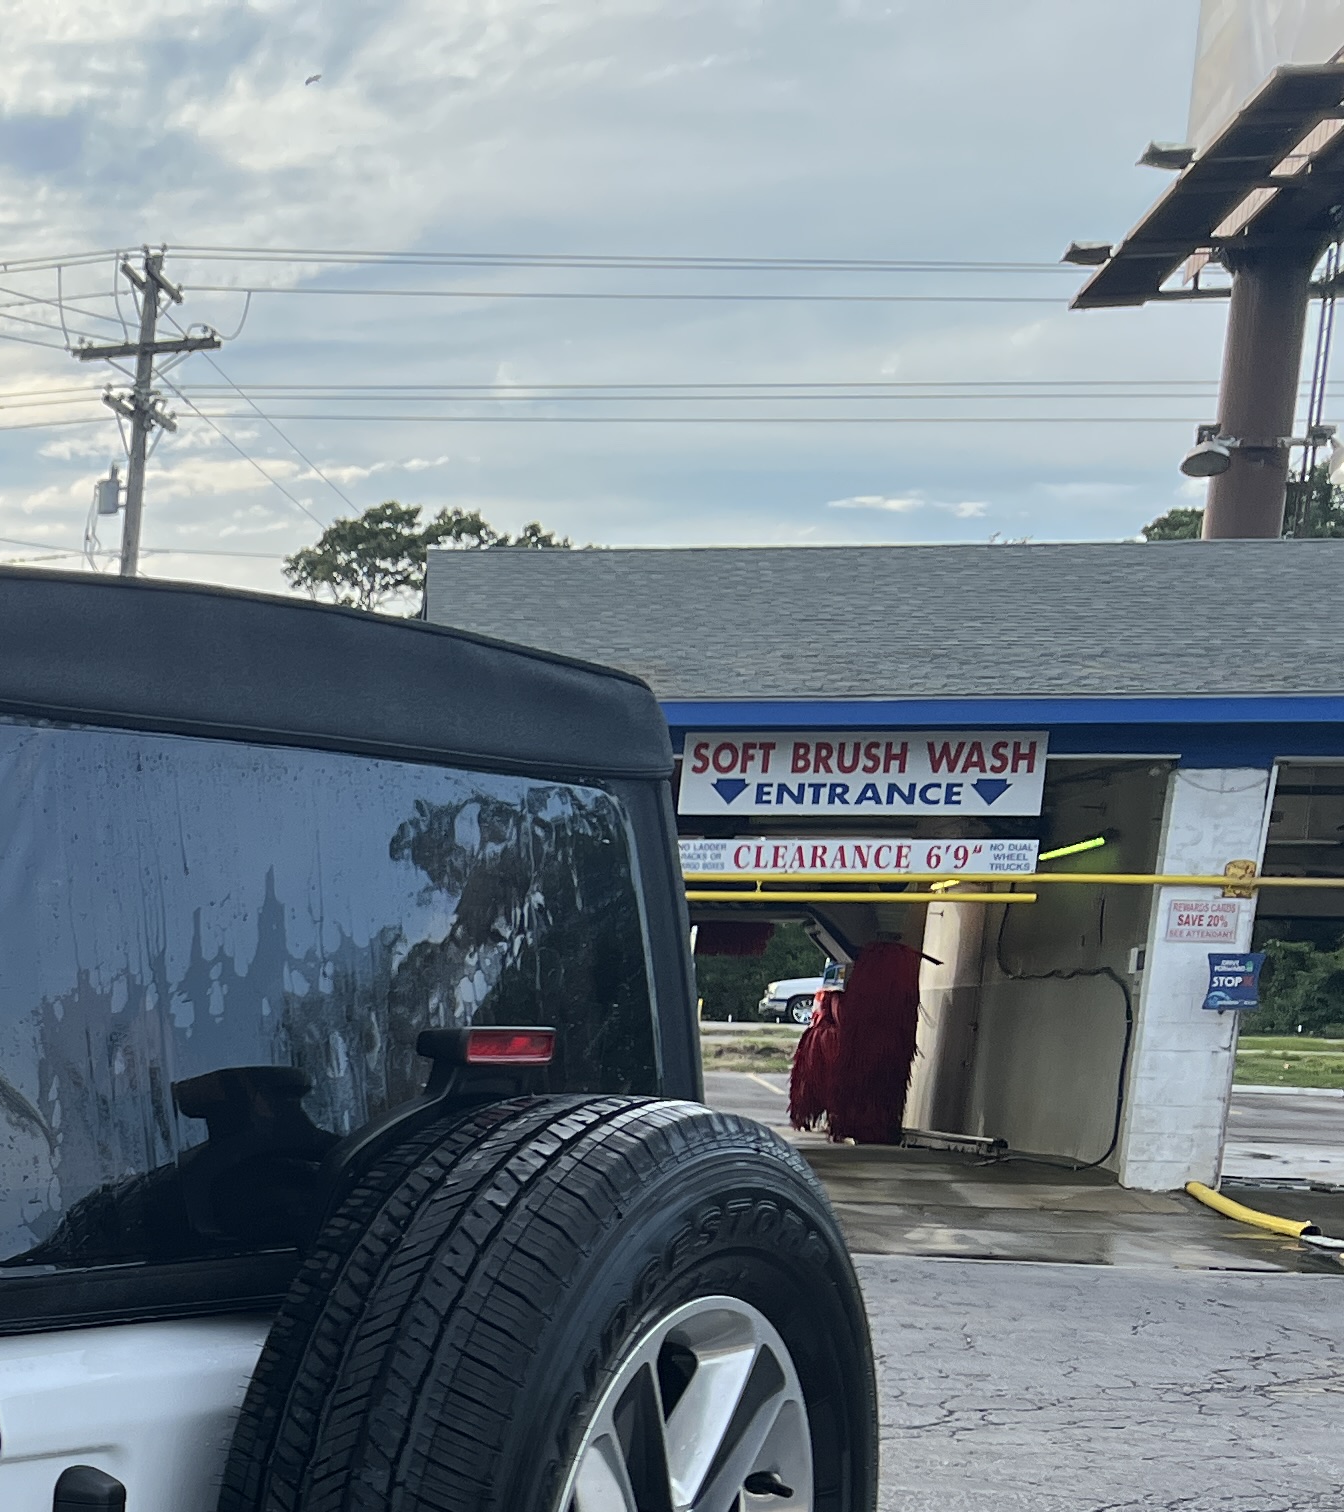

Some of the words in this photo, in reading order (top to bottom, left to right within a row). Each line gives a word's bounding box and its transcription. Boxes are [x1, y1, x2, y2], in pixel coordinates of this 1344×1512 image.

[691, 741, 777, 774] SOFT
[790, 741, 909, 774] BRUSH
[926, 741, 1038, 774] WASH
[754, 782, 965, 806] ENTRANCE
[693, 843, 727, 851] LADDER
[1008, 843, 1033, 851] DUAL
[733, 844, 912, 870] CLEARANCE
[993, 853, 1029, 861] WHEEL
[989, 863, 1030, 871] TRUCKS
[1173, 903, 1210, 913] REWARDS
[1177, 914, 1205, 927] SAVE
[1207, 915, 1228, 927] 20%
[1186, 930, 1233, 938] ATTENDANT
[1212, 976, 1243, 987] STOP
